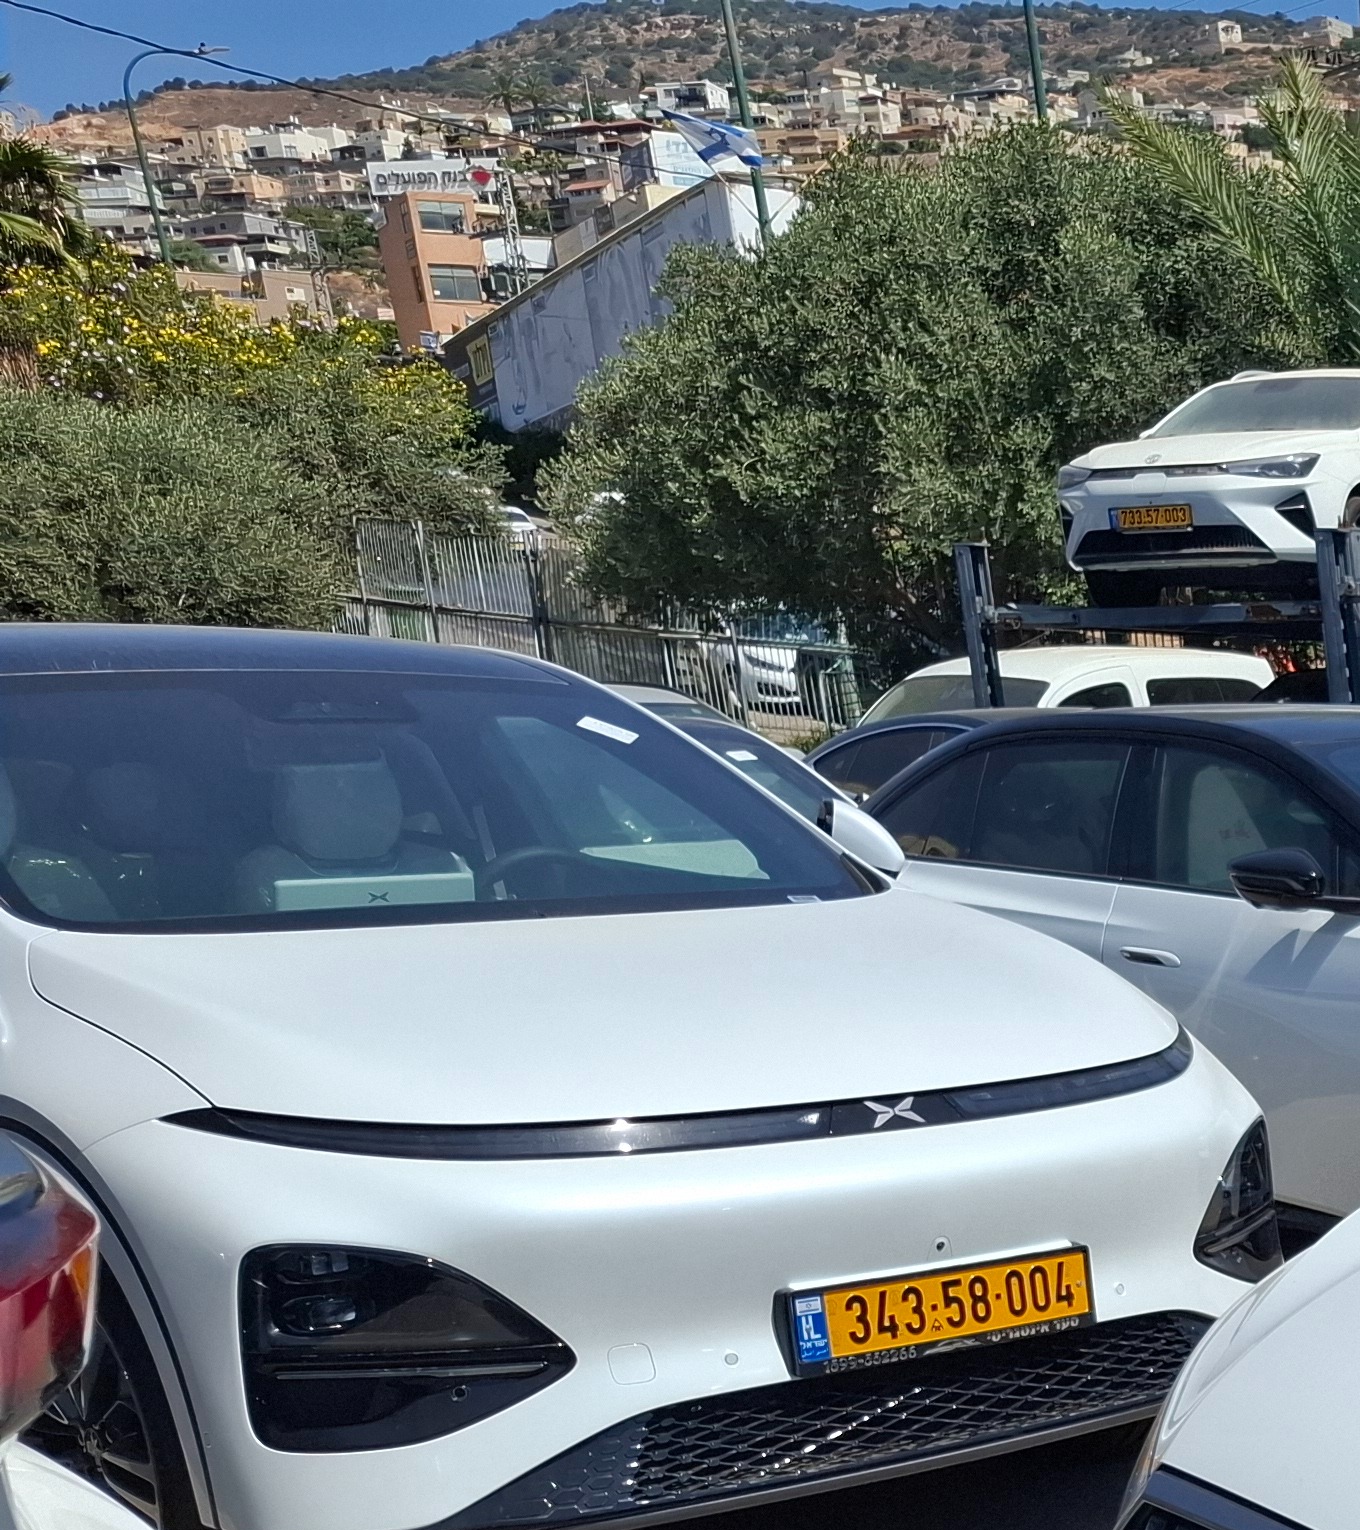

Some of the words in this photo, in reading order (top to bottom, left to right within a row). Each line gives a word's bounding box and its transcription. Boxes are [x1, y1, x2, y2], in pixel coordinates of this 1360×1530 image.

[376, 170, 439, 186] הפועלים
[1053, 1316, 1080, 1331] סער
[987, 1322, 1050, 1342] אינטגריטי
[800, 1339, 828, 1350] ישראל
